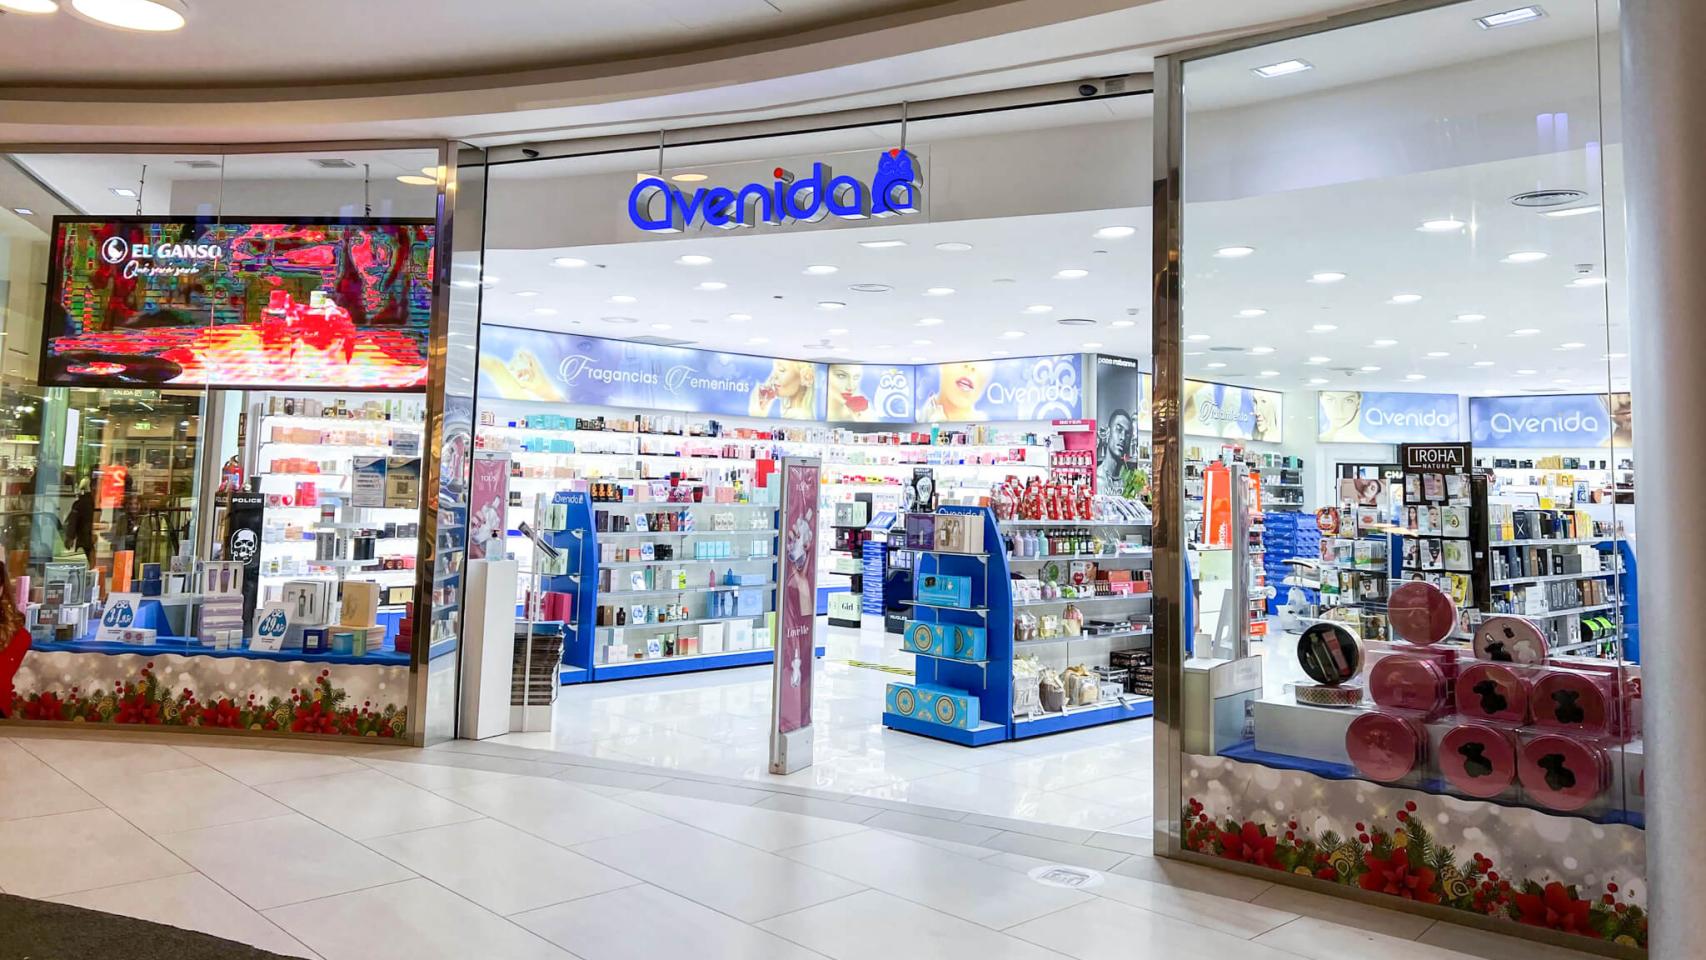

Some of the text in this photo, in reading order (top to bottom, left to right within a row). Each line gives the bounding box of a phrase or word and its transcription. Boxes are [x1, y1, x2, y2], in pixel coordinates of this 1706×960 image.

[131, 243, 222, 258] EL GANSO
[556, 354, 750, 395] Fragancias Femeninas
[1415, 449, 1457, 463] IROHA
